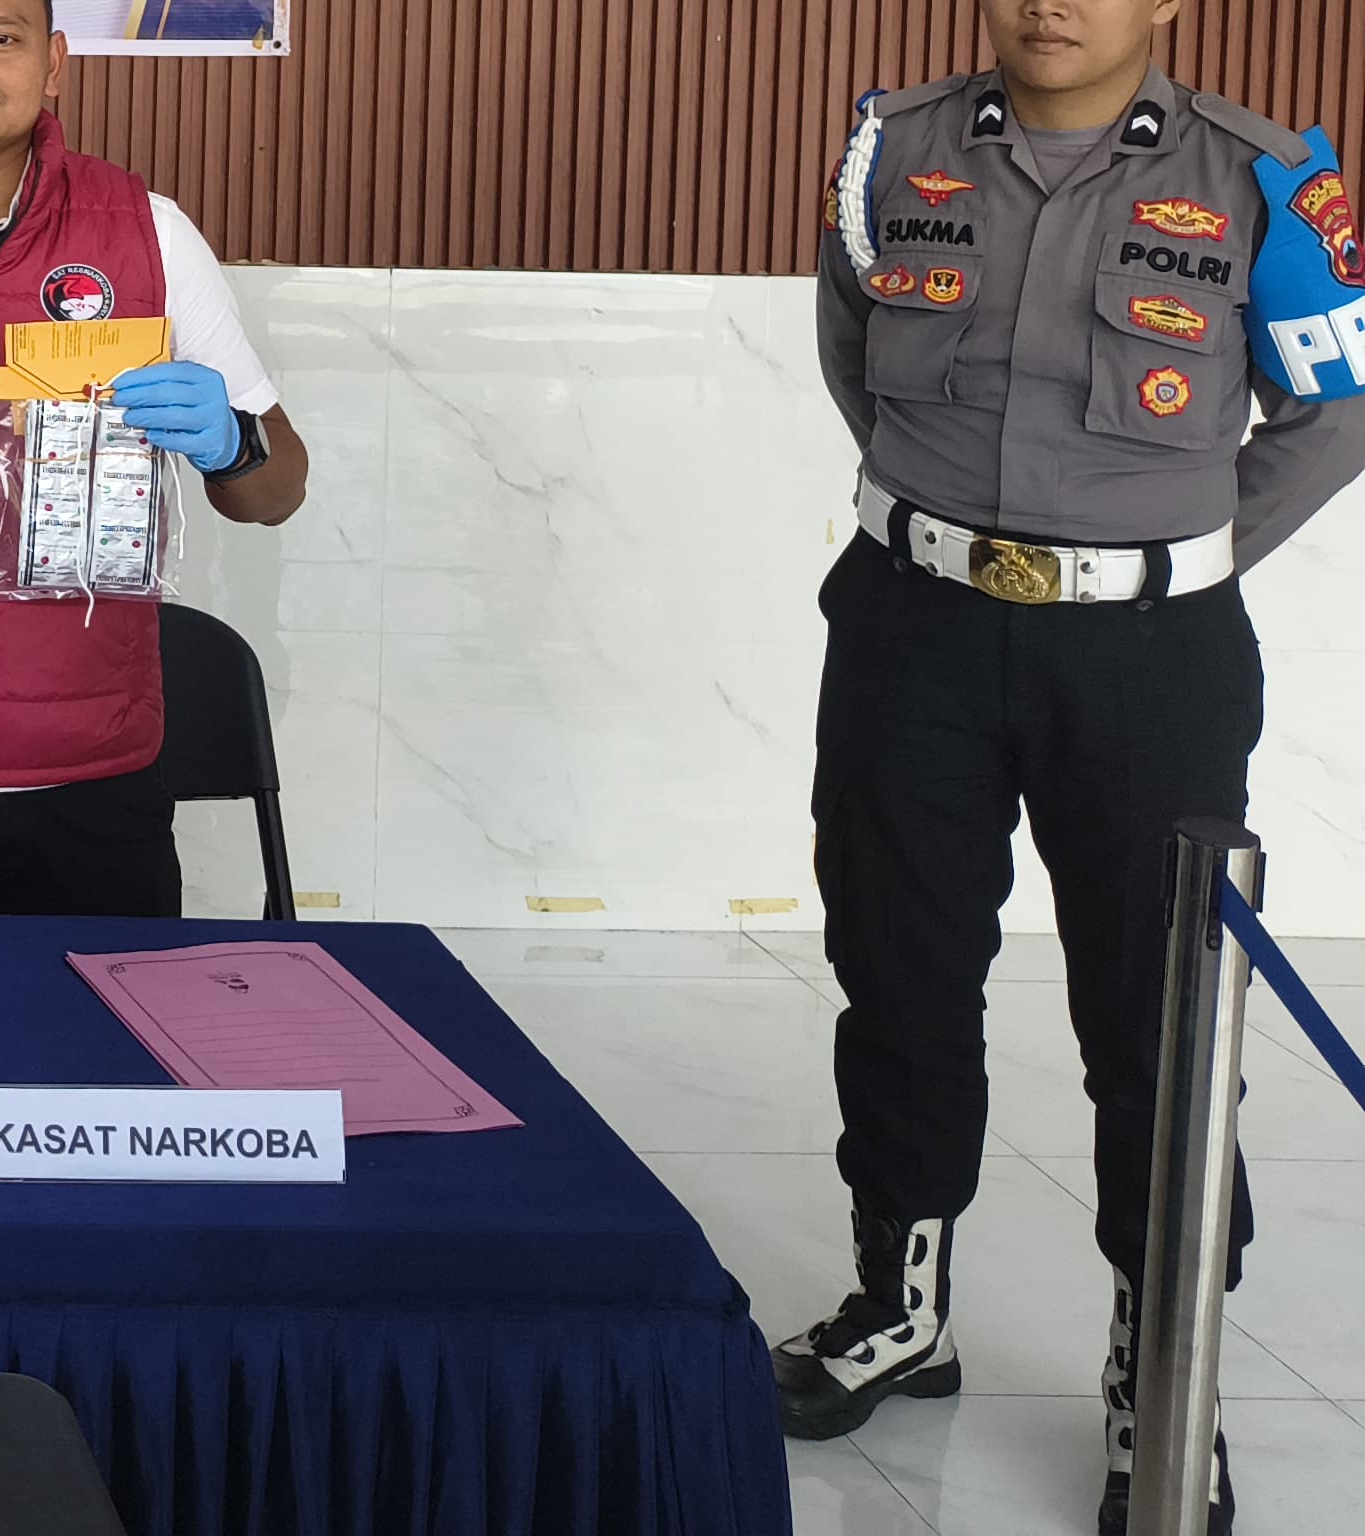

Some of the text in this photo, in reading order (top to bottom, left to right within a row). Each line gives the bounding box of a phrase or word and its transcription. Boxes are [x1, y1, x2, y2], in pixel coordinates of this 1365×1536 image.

[885, 219, 974, 246] SUKMA
[1120, 242, 1232, 285] POLRI
[130, 1126, 319, 1159] NARKOBA
